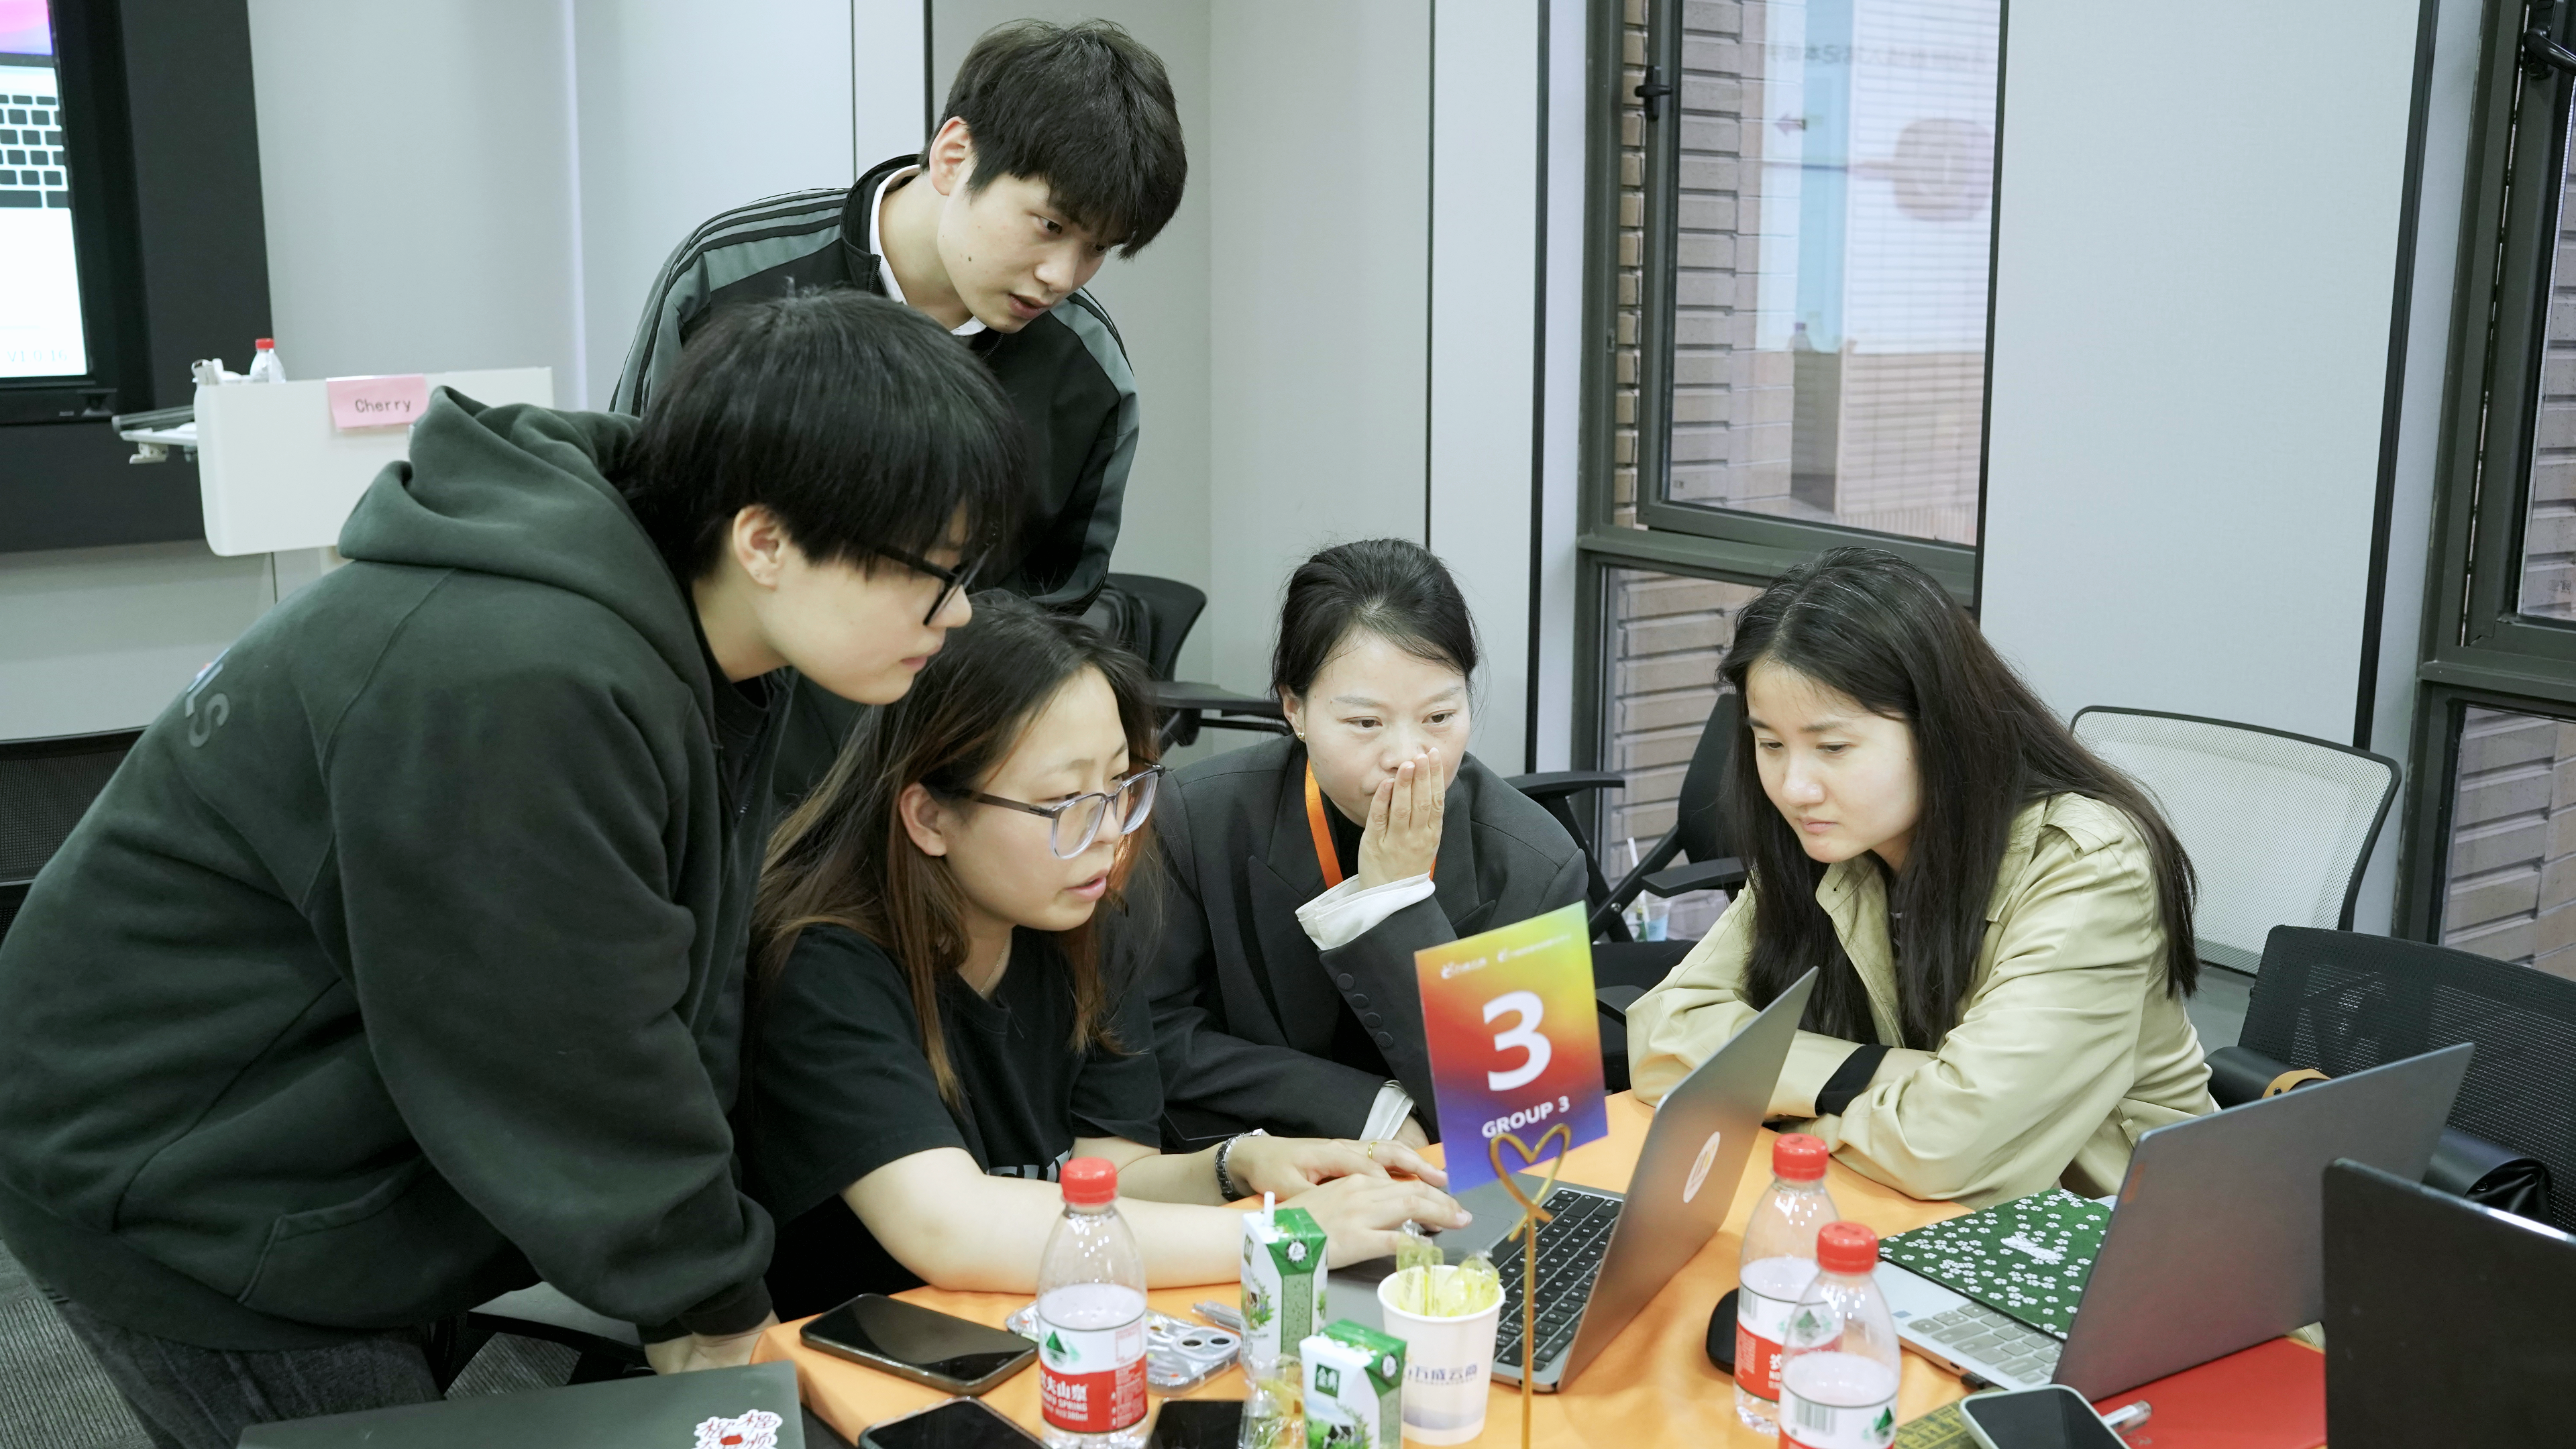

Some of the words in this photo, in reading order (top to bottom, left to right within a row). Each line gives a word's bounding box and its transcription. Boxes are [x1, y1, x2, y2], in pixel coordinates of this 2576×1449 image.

[355, 398, 411, 413] Cherry
[1482, 989, 1552, 1091] 3
[1481, 1102, 1554, 1139] GROUP
[1558, 1095, 1570, 1114] 3
[1058, 1397, 1088, 1413] SPRING
